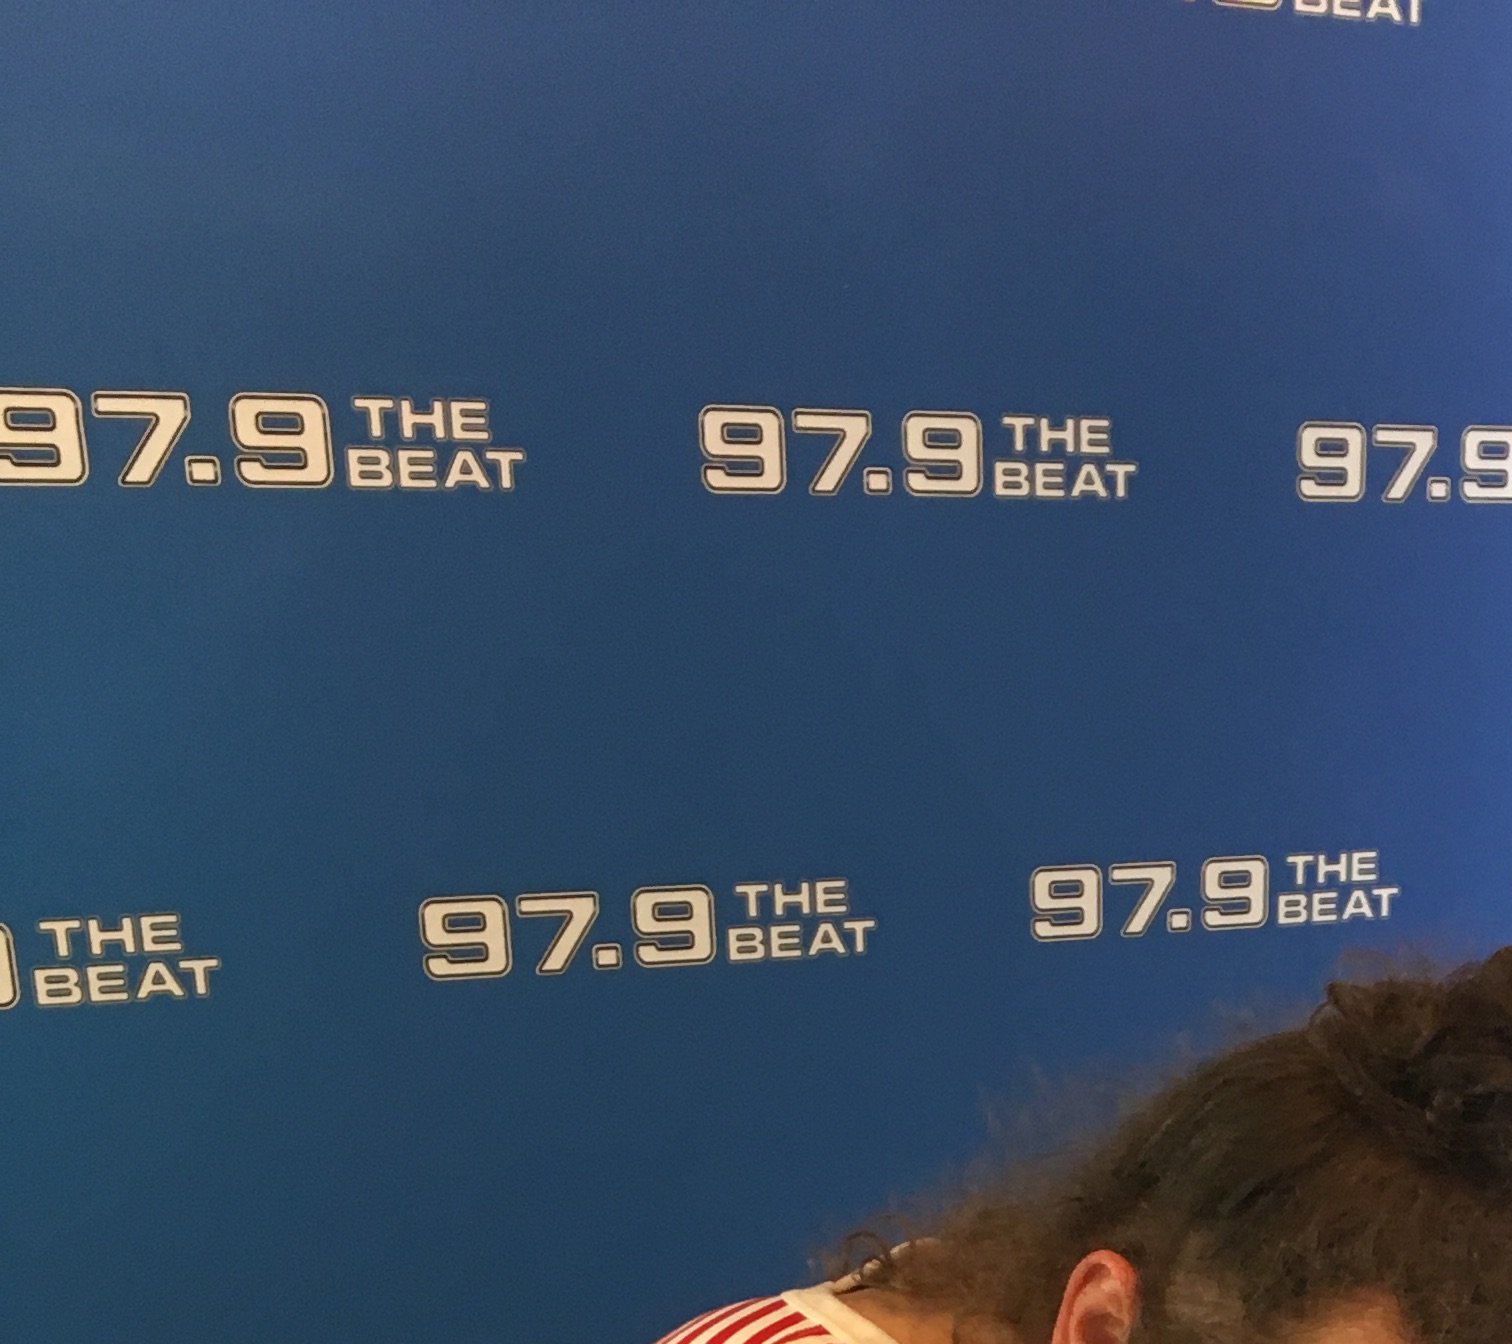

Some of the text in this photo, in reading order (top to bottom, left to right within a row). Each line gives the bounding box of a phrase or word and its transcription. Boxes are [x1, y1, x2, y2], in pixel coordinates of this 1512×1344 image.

[0, 388, 334, 487] 97.9
[352, 397, 491, 440] THE
[1001, 414, 1112, 454] THE
[346, 446, 525, 490] BEAT
[699, 405, 983, 496] 97.9
[994, 459, 1139, 499] BEAT
[1286, 850, 1379, 886] THE
[735, 878, 849, 917] THE
[1030, 854, 1269, 942] 97.9
[1276, 886, 1400, 926] BEAT
[37, 912, 183, 958] THE
[419, 884, 716, 981] 97.9
[726, 918, 877, 964] BEAT
[33, 957, 221, 1006] BEAT
